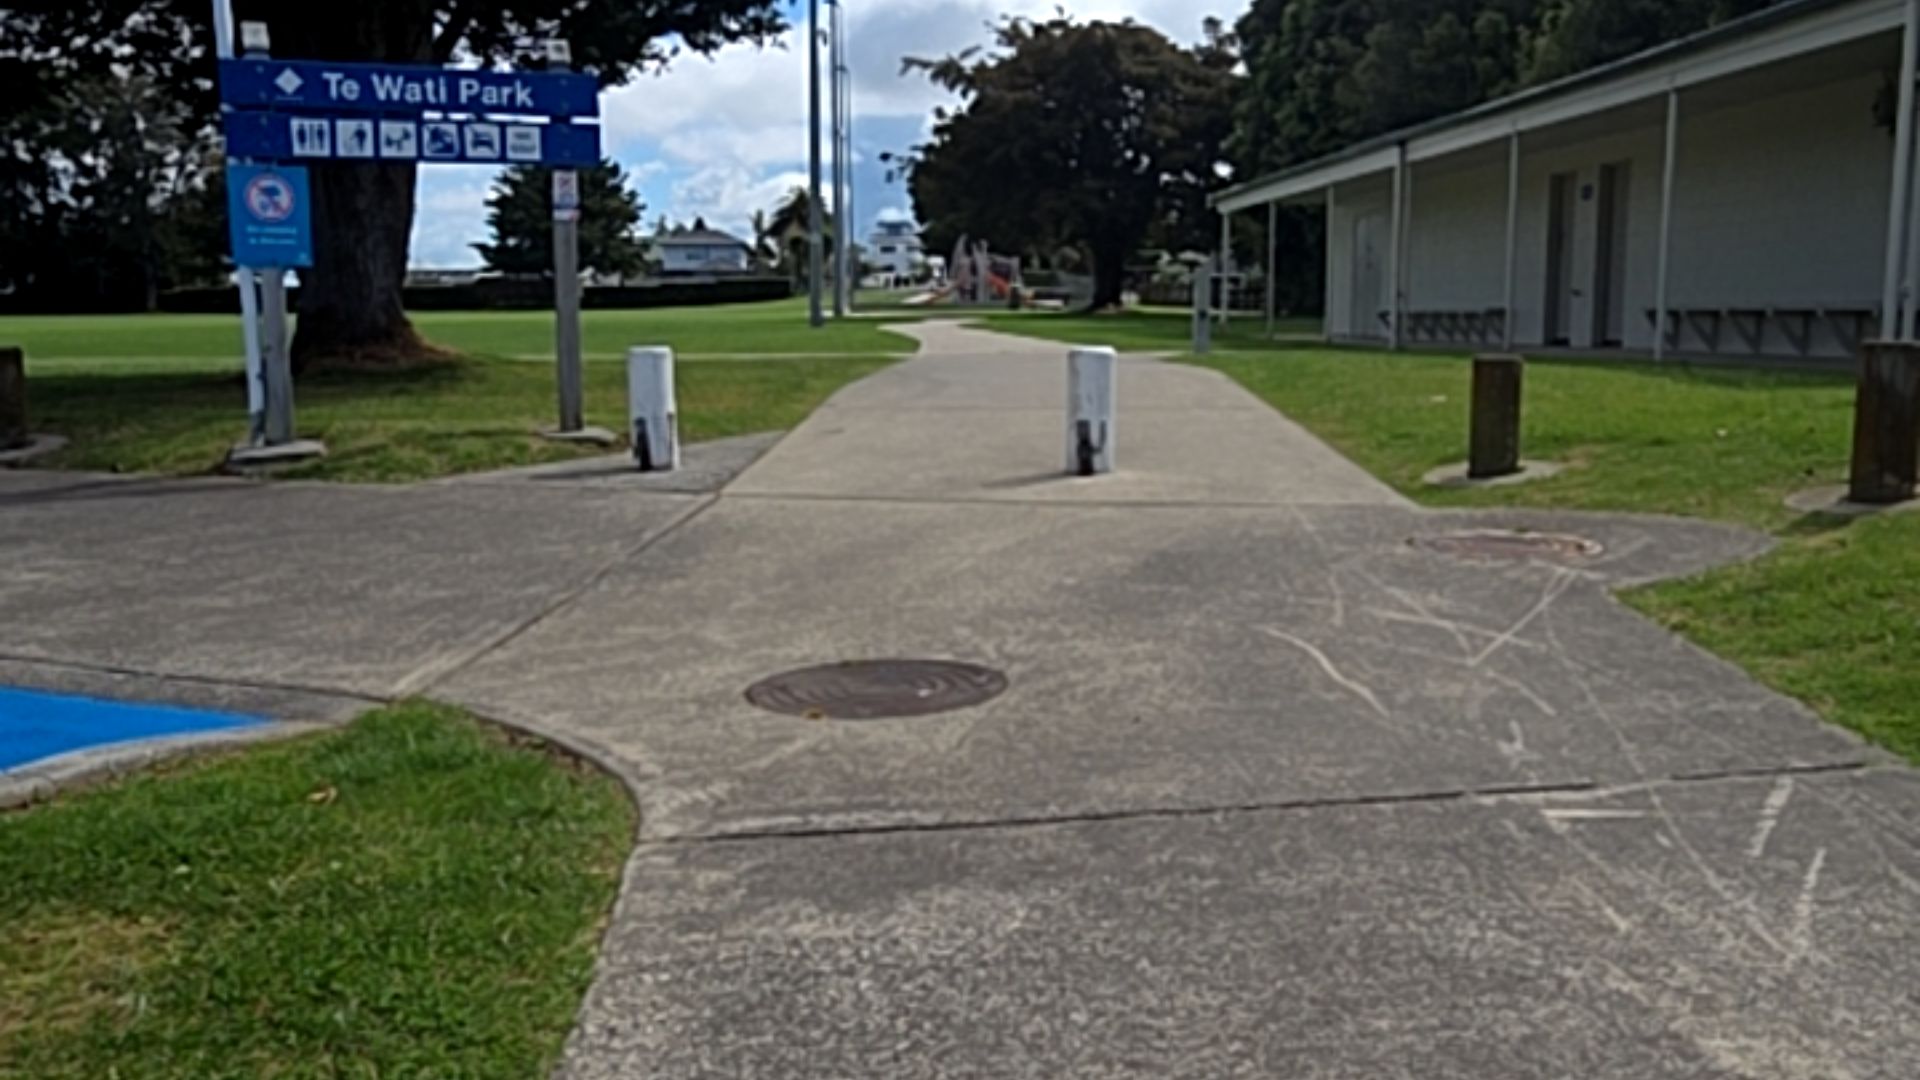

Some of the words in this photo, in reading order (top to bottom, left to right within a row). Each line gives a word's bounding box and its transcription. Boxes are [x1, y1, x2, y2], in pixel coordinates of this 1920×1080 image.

[322, 72, 360, 101] Te
[371, 73, 447, 104] Wati
[459, 78, 534, 108] Park
